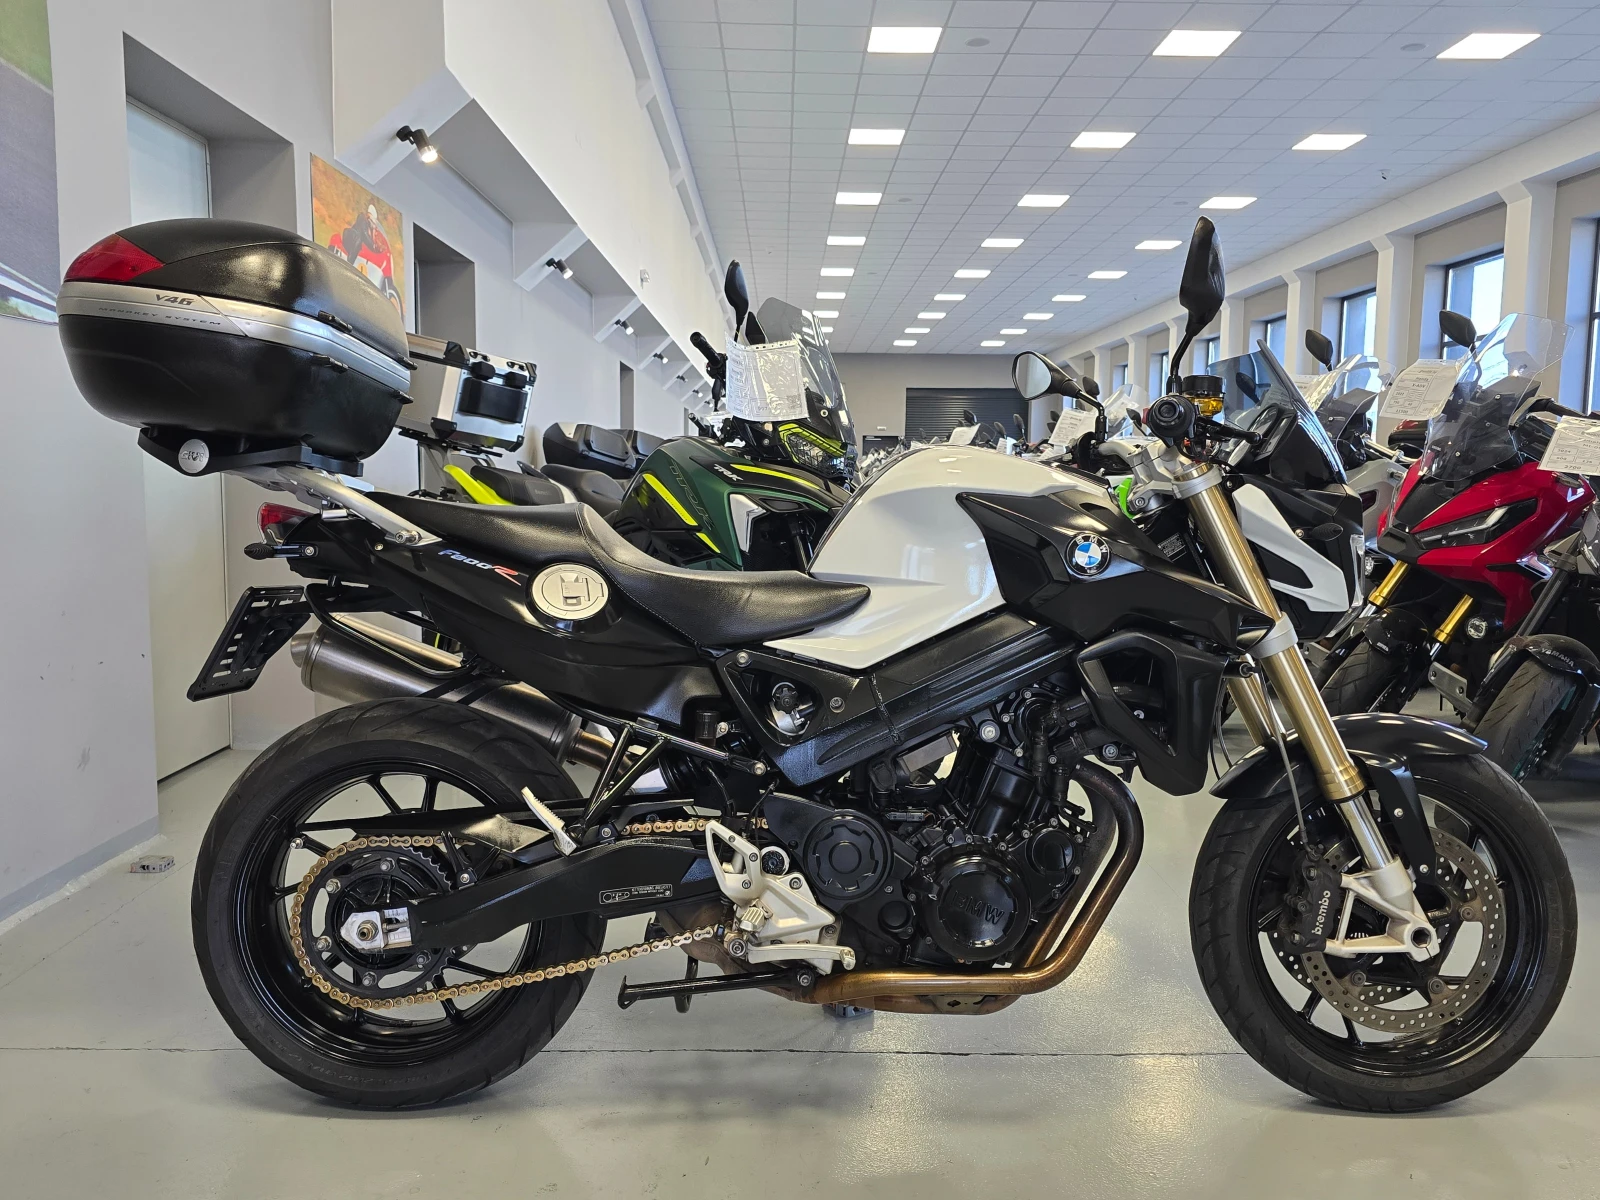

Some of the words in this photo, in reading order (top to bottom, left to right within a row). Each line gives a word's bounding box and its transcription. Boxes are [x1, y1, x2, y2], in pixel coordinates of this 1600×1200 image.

[155, 294, 195, 306] V46
[98, 307, 158, 317] MONOKEY
[164, 315, 222, 326] SYSTEM
[713, 463, 744, 481] TRK
[1075, 534, 1108, 553] BMW
[1541, 647, 1575, 667] YAMAHA
[951, 890, 1005, 925] BMW
[1311, 890, 1331, 935] brembo
